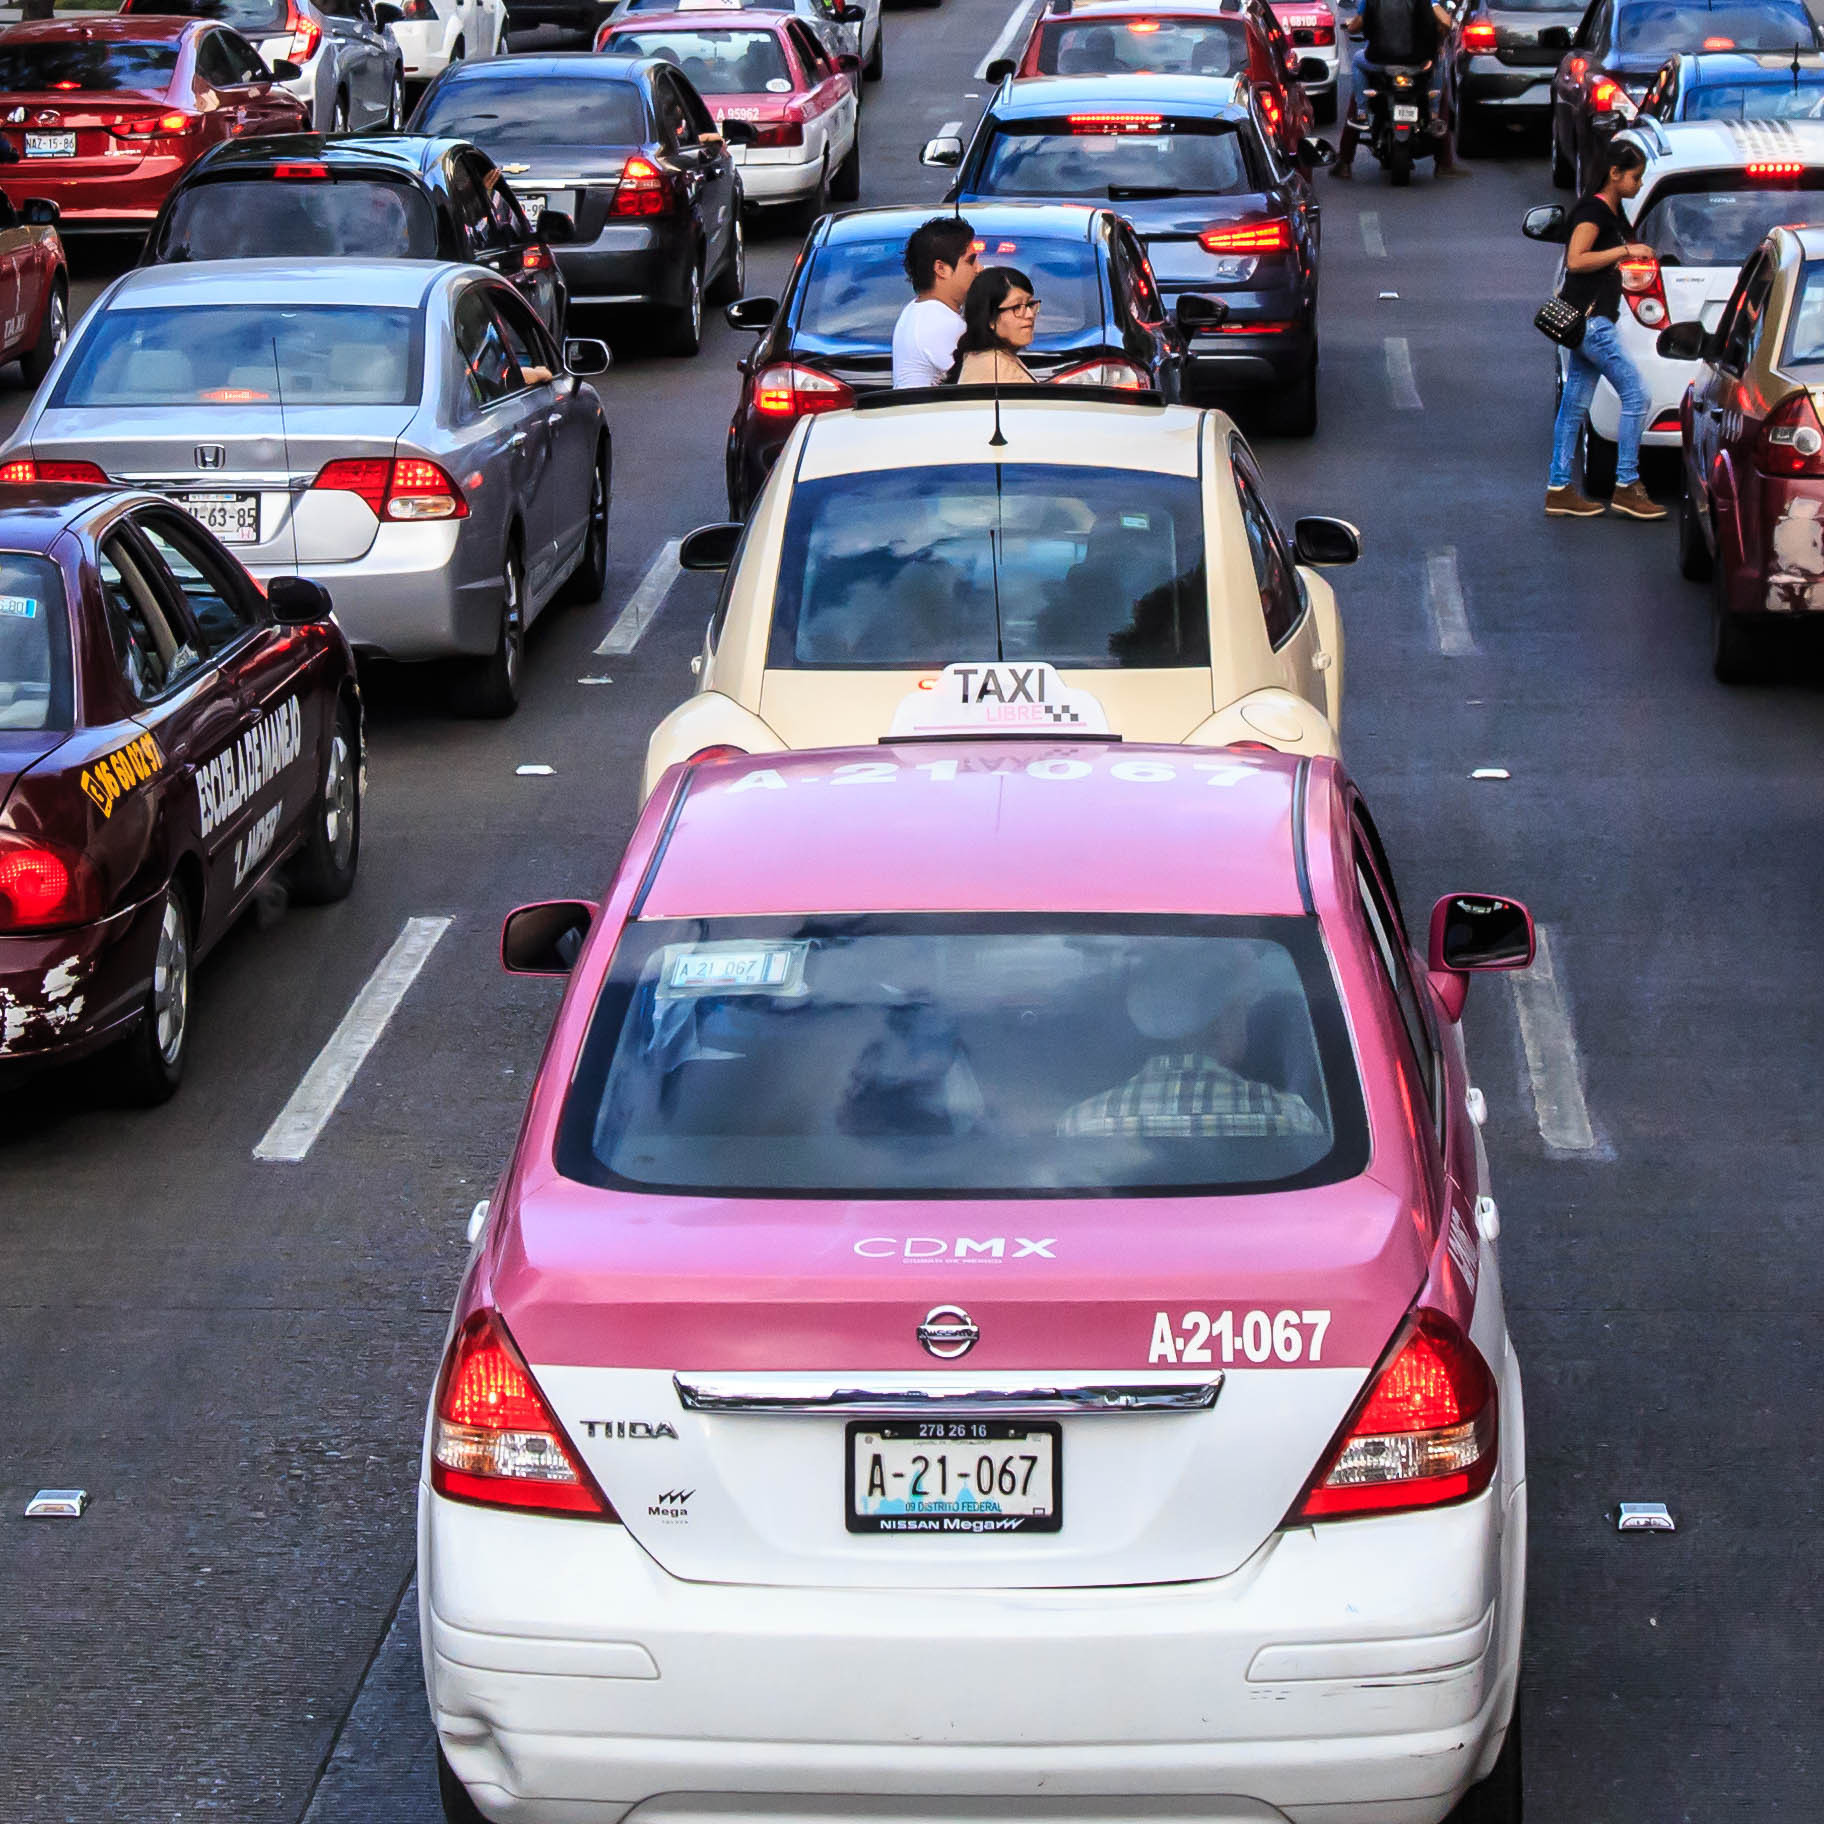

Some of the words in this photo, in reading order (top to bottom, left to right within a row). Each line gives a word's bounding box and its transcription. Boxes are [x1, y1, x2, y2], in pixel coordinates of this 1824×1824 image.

[716, 109, 724, 121] A
[953, 668, 1045, 704] TAXI
[986, 705, 1043, 723] LIBRE
[94, 759, 121, 801] 16
[109, 751, 137, 792] 60
[126, 743, 151, 780] 02
[140, 732, 163, 772] 97
[195, 739, 248, 840] ESCUELA
[244, 726, 264, 796] DE
[259, 694, 301, 787] MANEJO
[853, 1237, 1059, 1258] CDMX
[1148, 1309, 1332, 1364] A-21-067
[579, 1420, 680, 1440] TIIDA
[919, 1424, 945, 1437] 278
[949, 1424, 966, 1437] 26
[970, 1424, 987, 1437] 16
[867, 1453, 1038, 1497] A-21-067
[648, 1506, 688, 1518] Mega
[918, 1502, 959, 1512] DISTRITO
[961, 1502, 1003, 1513] FEDERAL
[880, 1520, 940, 1530] NISSAN
[944, 1518, 997, 1533] Mega
